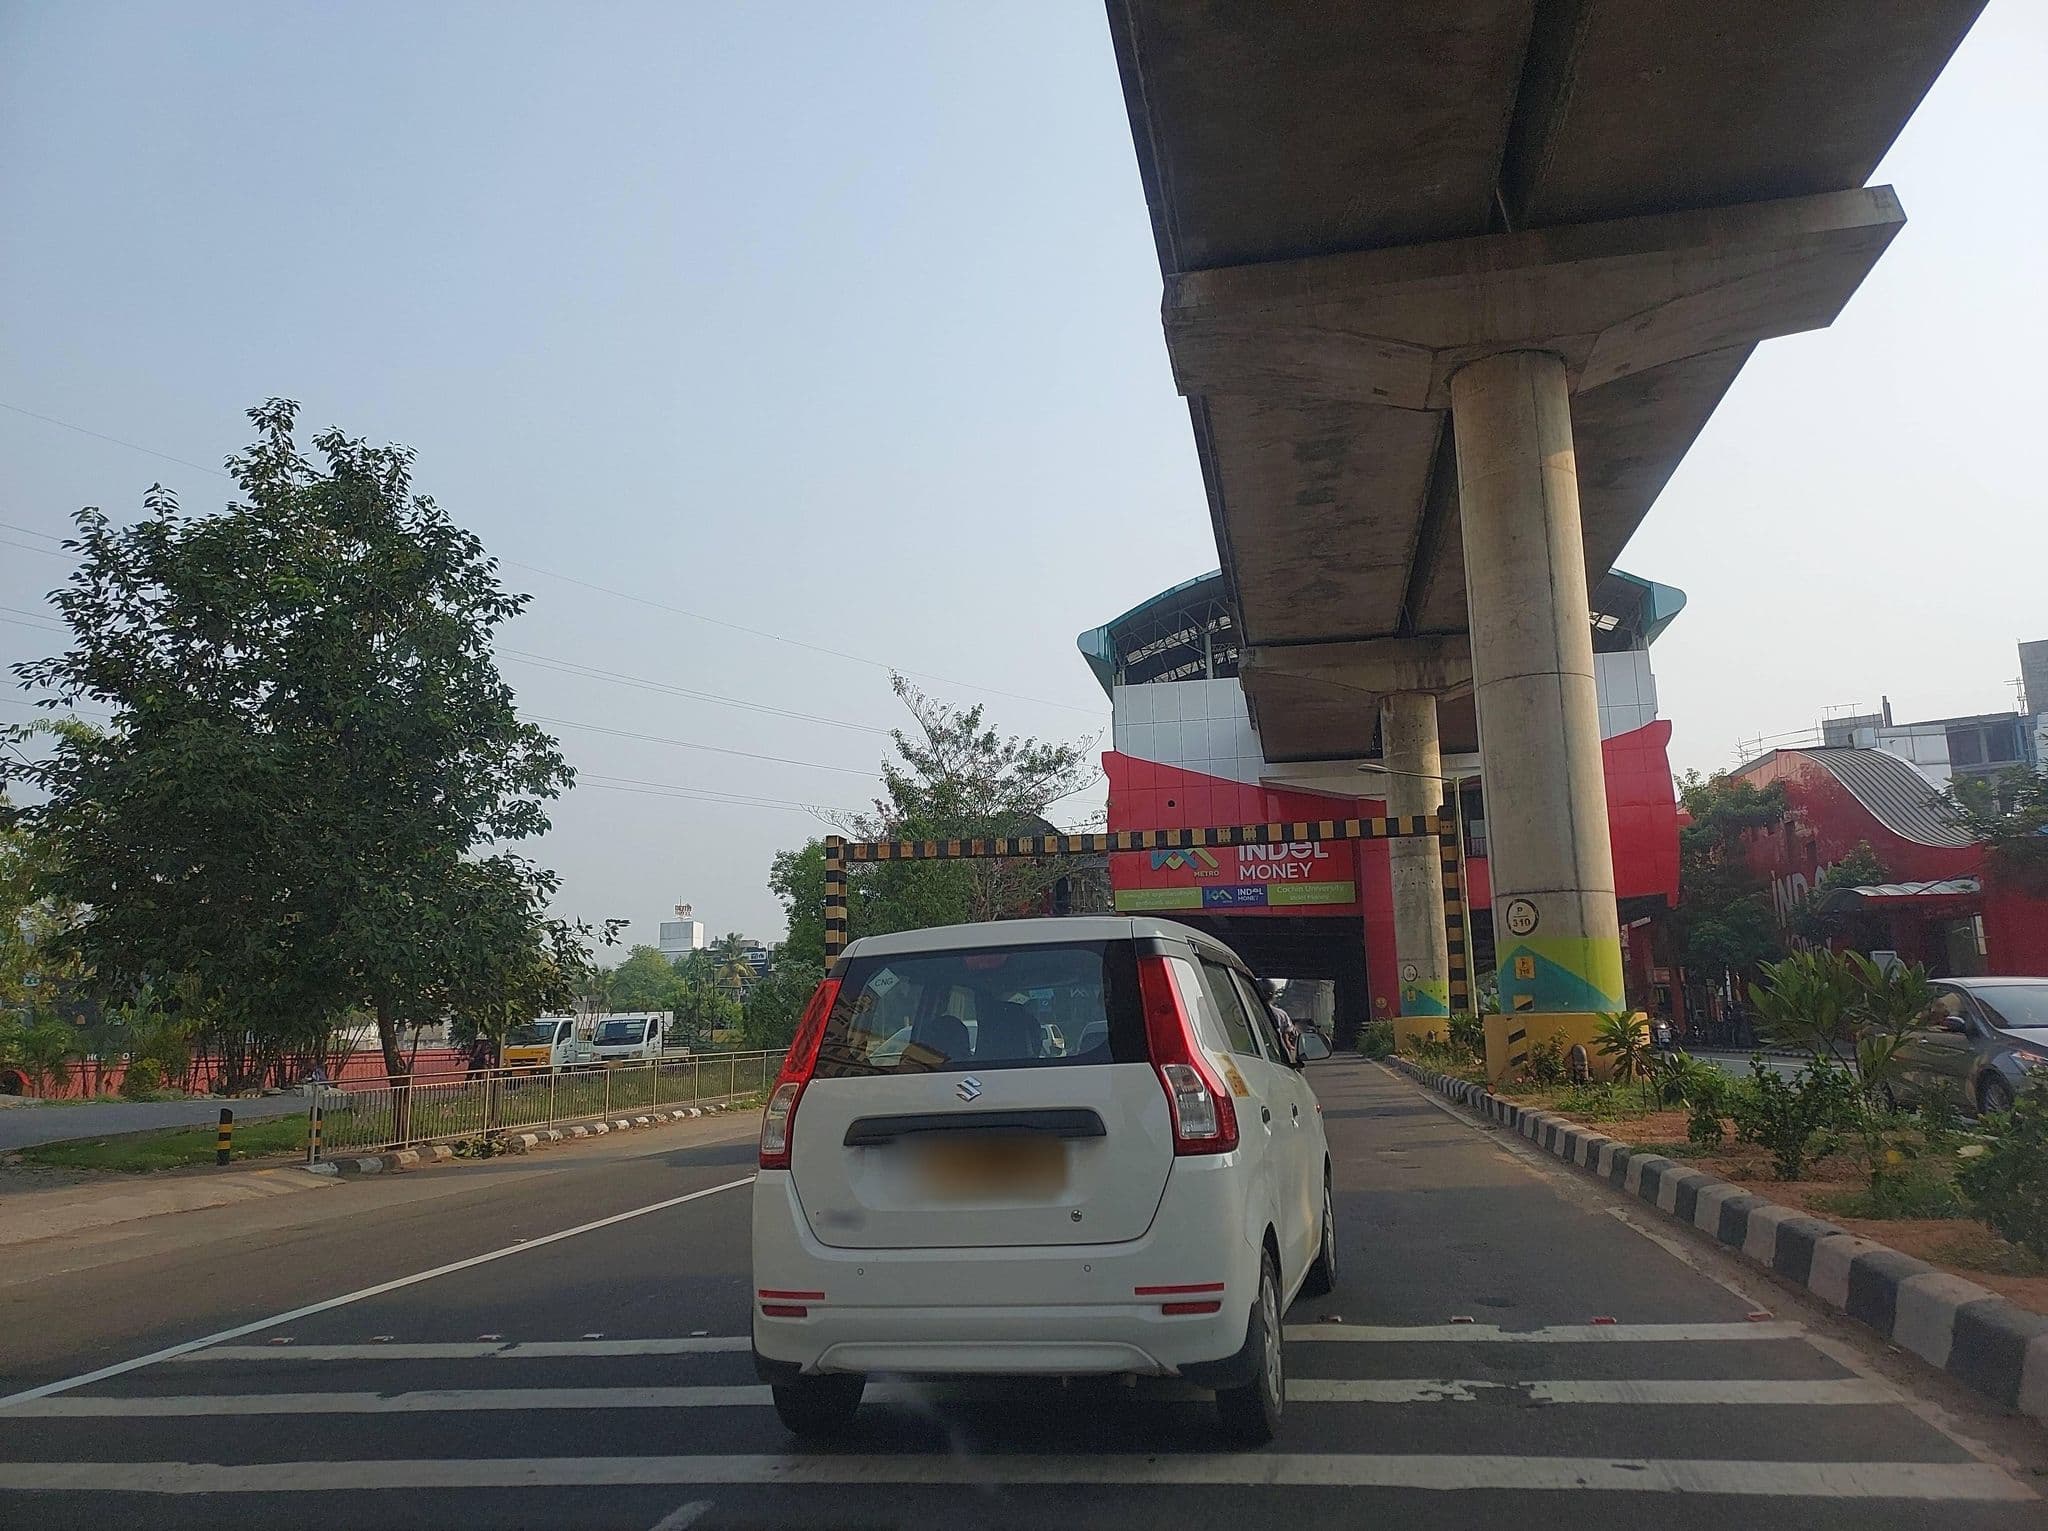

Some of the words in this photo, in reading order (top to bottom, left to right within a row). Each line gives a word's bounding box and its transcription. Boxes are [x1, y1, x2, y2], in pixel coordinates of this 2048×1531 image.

[1240, 862, 1313, 880] MONEY
[1512, 918, 1530, 927] 310
[874, 977, 893, 987] CNG
